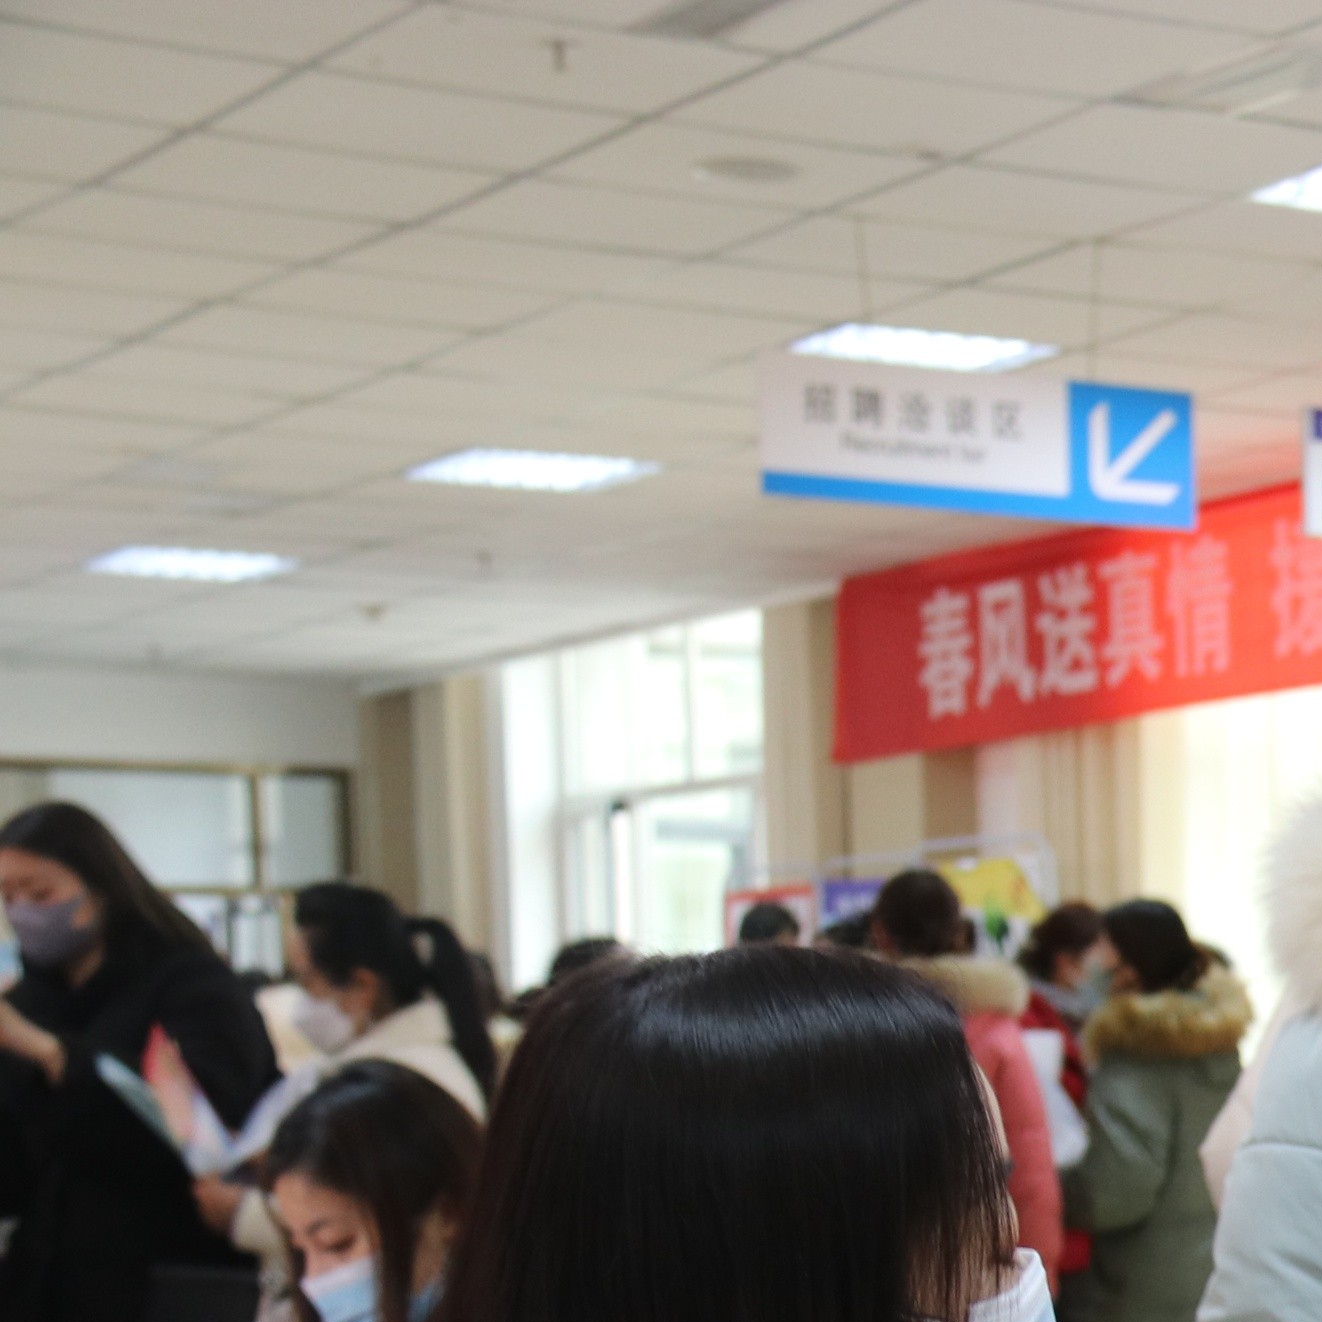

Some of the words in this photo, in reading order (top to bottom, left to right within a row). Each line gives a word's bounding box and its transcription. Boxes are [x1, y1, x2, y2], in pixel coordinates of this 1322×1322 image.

[802, 383, 1021, 442] 招聘洽谈区
[917, 535, 1234, 720] 春风送真情
